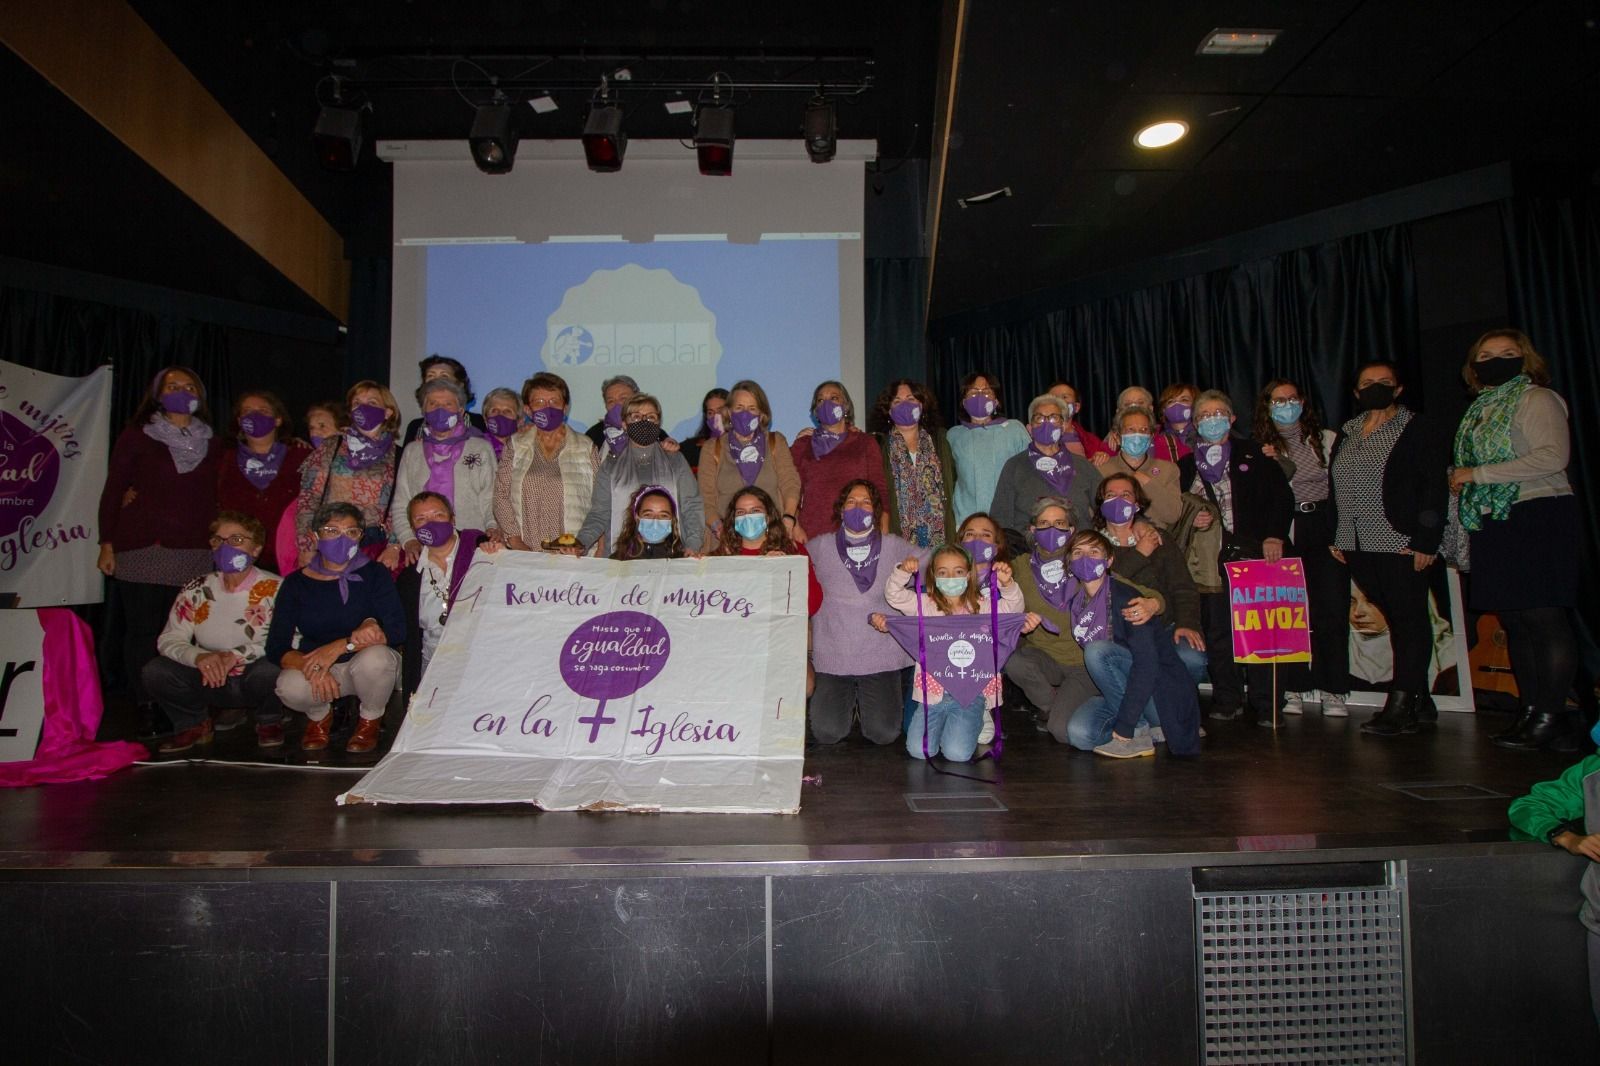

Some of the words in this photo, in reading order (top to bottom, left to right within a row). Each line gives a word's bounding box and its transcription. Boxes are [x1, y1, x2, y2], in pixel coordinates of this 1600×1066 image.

[594, 323, 709, 366] alandar
[20, 400, 81, 459] mujeres
[0, 515, 92, 571] glesia
[506, 581, 599, 606] Revuelta
[621, 583, 650, 606] de
[663, 587, 756, 618] mujeres
[1232, 586, 1307, 604] ALCEMOS
[592, 625, 619, 633] Hasta
[624, 626, 640, 636] que
[1233, 609, 1262, 631] LA
[1264, 606, 1307, 630] VOZ
[570, 632, 666, 662] igualdad
[473, 712, 508, 736] en
[520, 694, 558, 738] la
[631, 704, 741, 756] Iglesia
